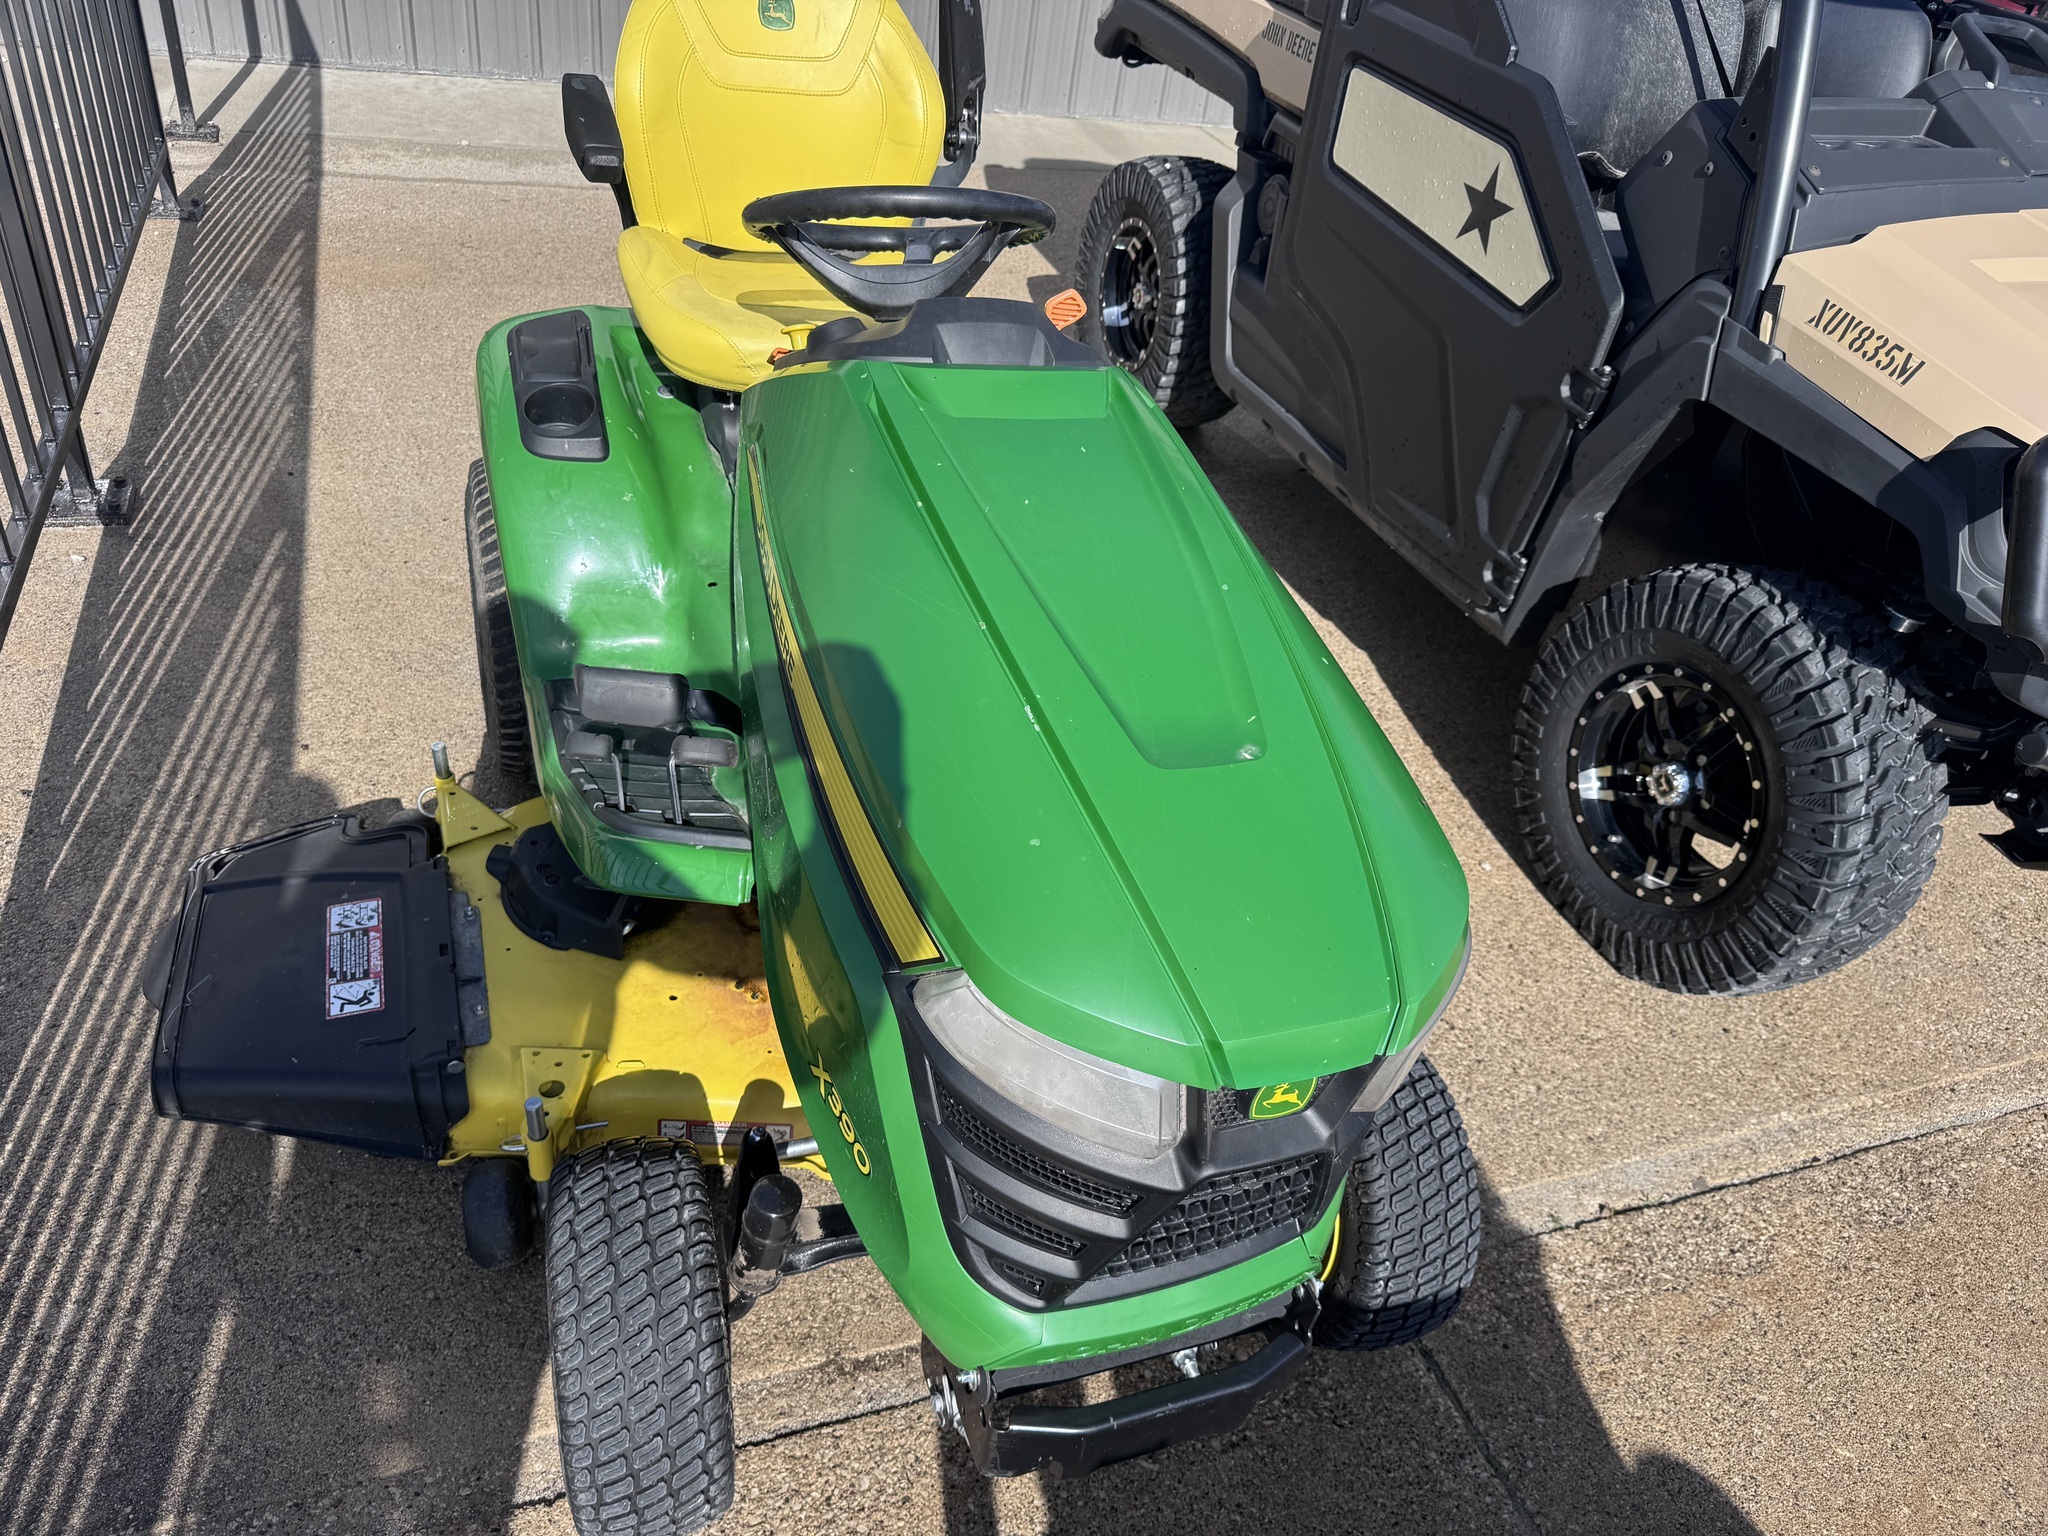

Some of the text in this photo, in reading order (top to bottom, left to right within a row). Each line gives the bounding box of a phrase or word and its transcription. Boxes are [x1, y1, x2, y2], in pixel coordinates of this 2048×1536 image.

[1261, 19, 1317, 63] JOHN DEERE
[1806, 298, 1926, 386] XUV835M
[768, 573, 796, 683] DEERE
[370, 940, 381, 973] DANGER
[809, 1048, 872, 1177] X390
